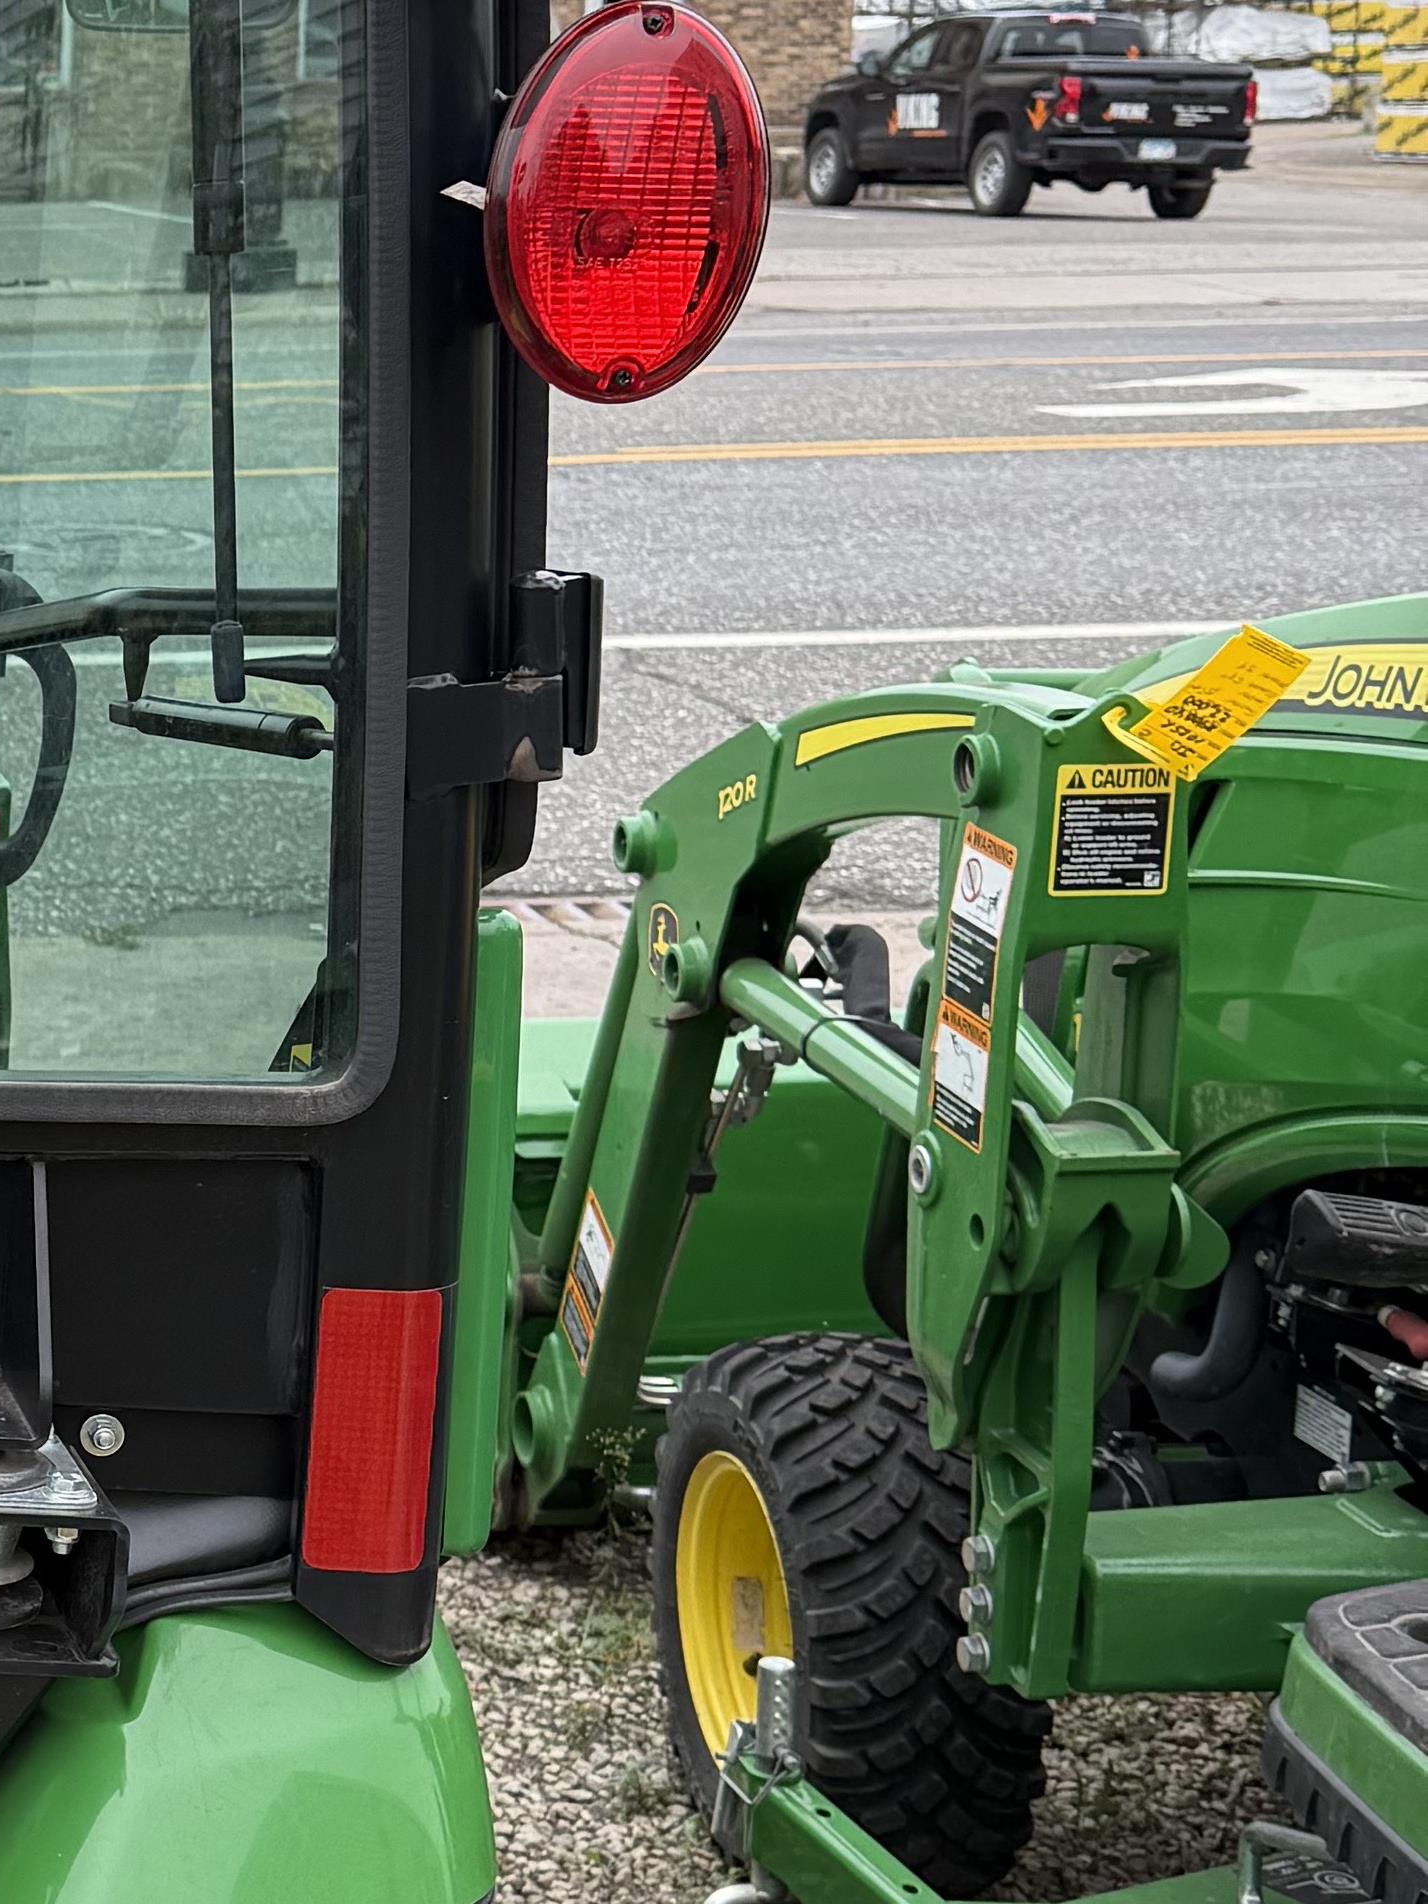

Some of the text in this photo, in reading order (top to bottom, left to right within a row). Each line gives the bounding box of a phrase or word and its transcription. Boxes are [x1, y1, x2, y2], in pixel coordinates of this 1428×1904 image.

[1306, 654, 1424, 704] JOHN
[1092, 767, 1170, 789] CAUTION
[972, 831, 1015, 866] WARNING
